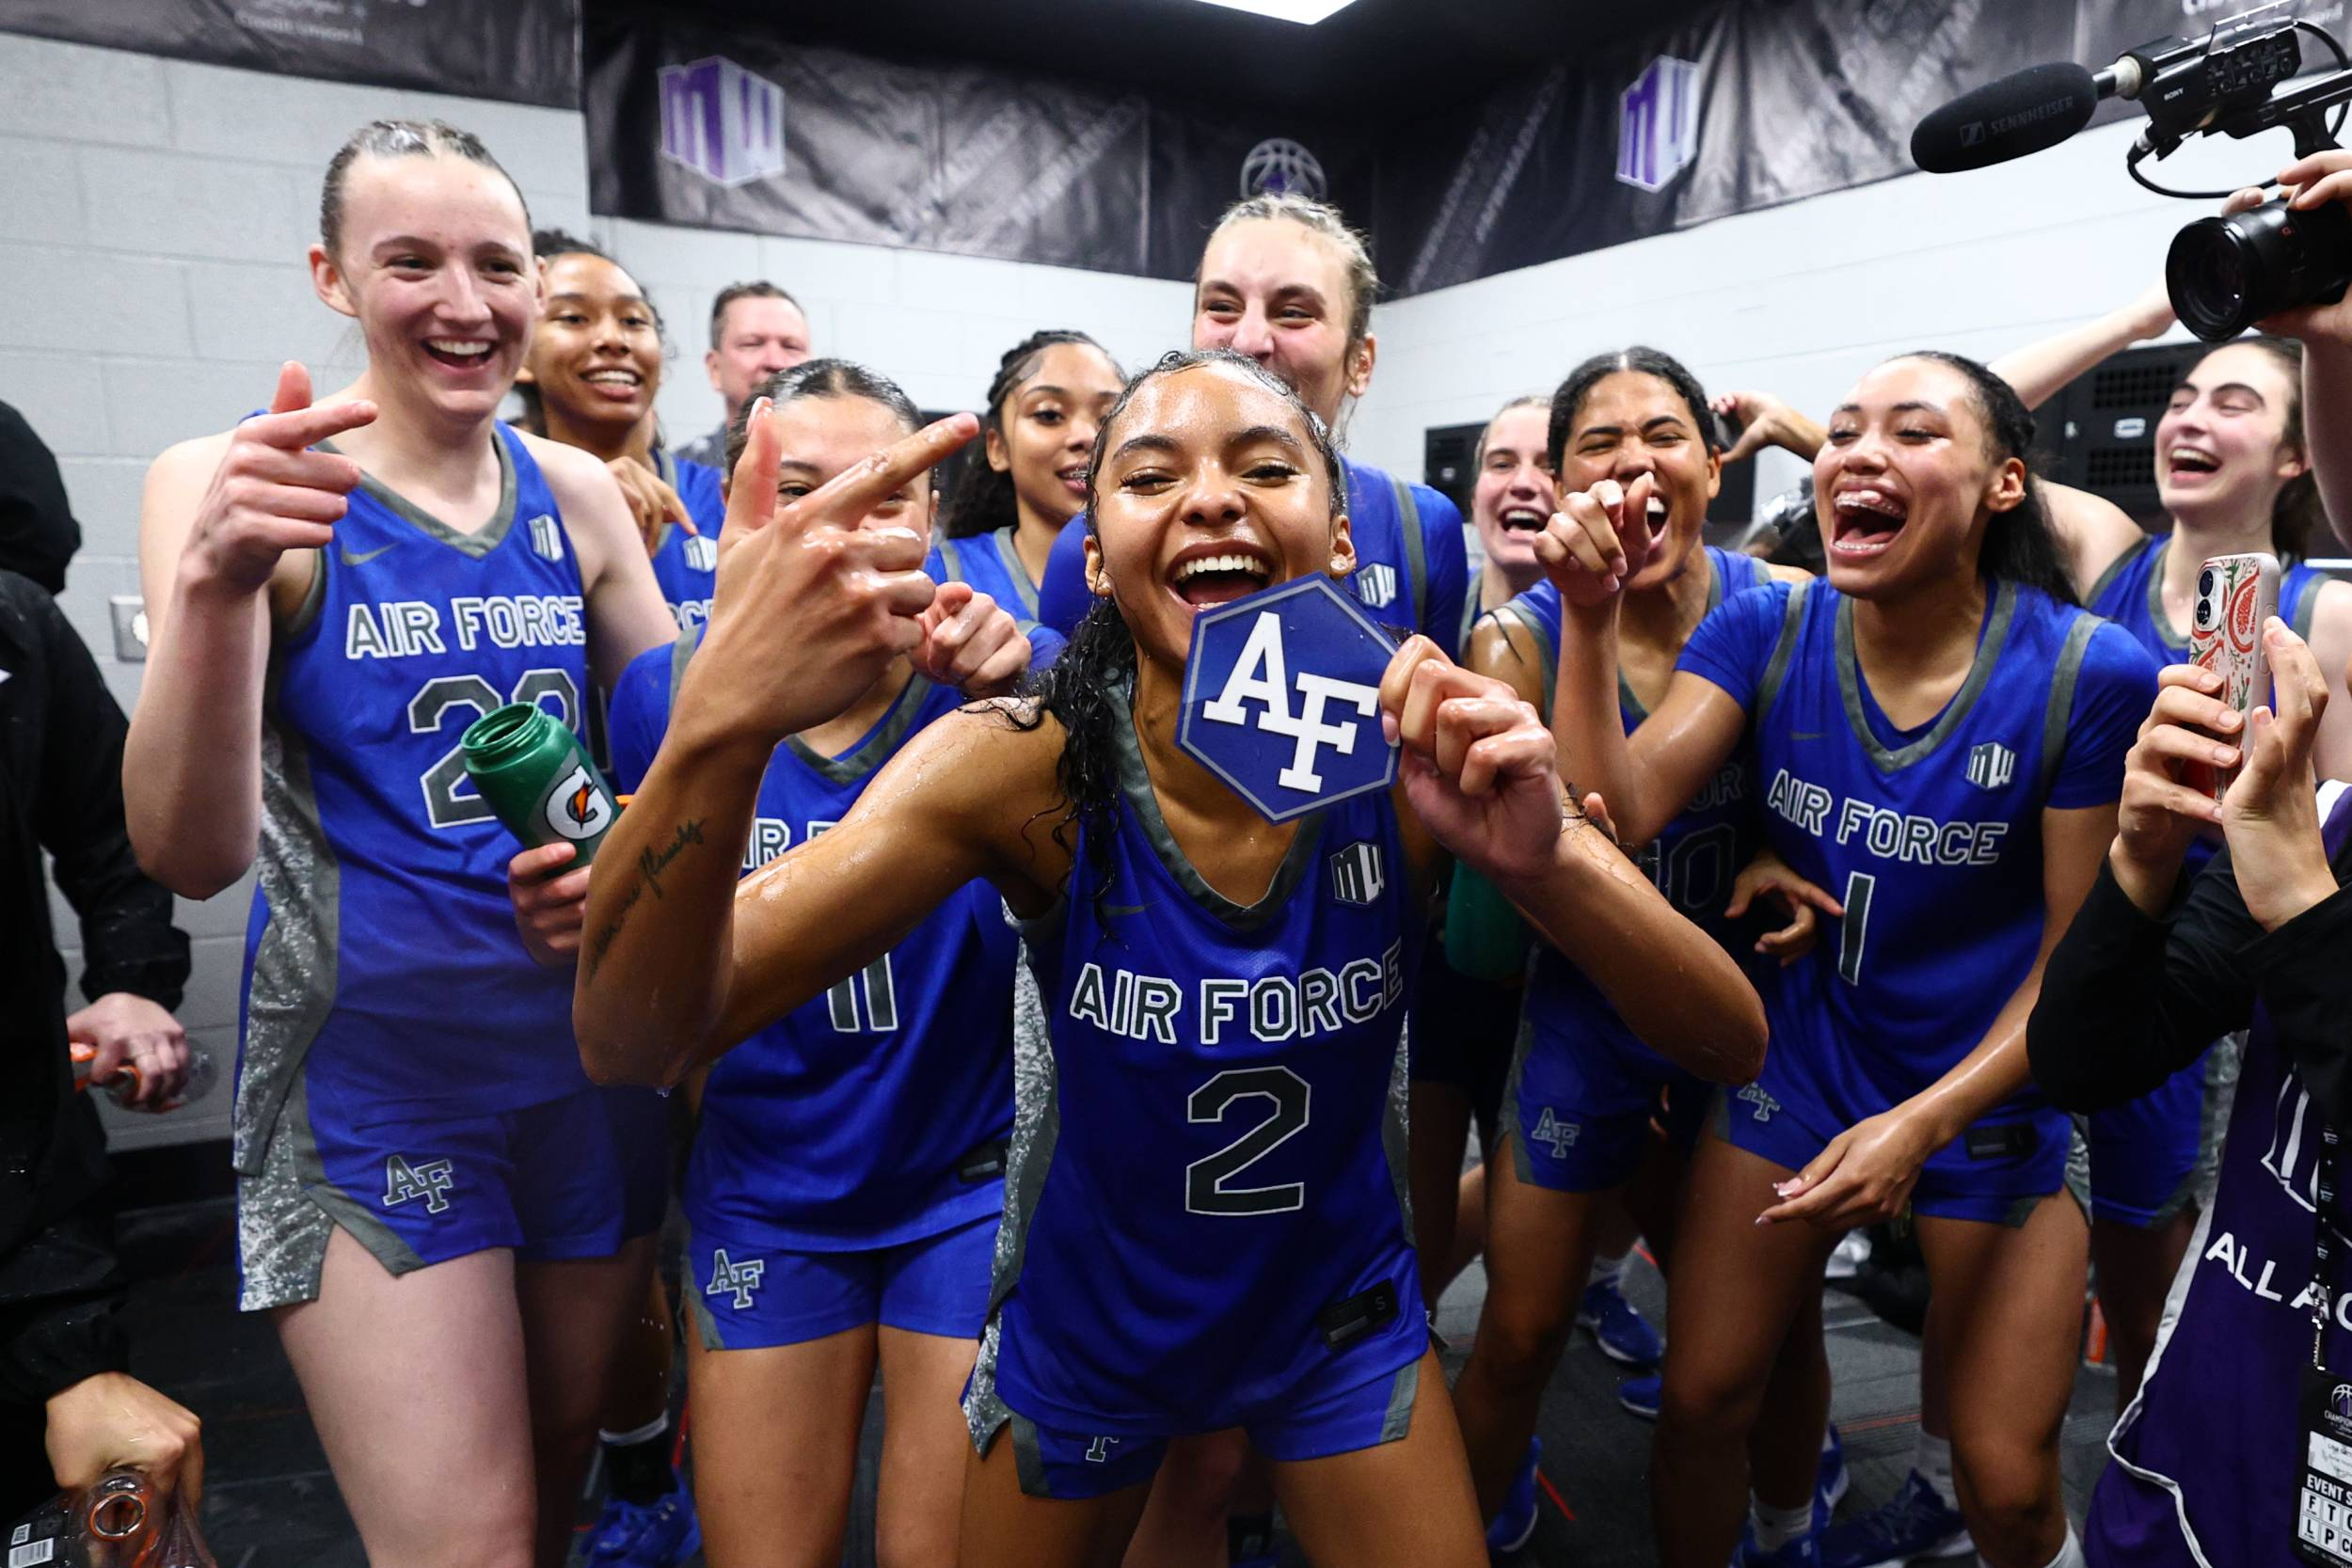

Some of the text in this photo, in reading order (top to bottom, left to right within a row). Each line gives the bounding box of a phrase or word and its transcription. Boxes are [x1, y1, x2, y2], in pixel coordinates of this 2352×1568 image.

[1990, 95, 2074, 135] SENNHEISER
[2164, 87, 2184, 101] SONY
[345, 595, 587, 659] AIR FORCE
[1202, 610, 1380, 794] AF
[544, 764, 612, 841] G
[1768, 768, 1833, 837] AIR
[1836, 797, 2010, 865] FORCE
[1838, 870, 1876, 987] 1
[1069, 935, 1403, 1046] AIR FORCE
[1185, 1065, 1311, 1216] 2
[1531, 1106, 1581, 1159] AF
[382, 1154, 453, 1213] AF
[707, 1248, 765, 1310] AF
[2204, 1231, 2283, 1303] ALL
[2306, 1473, 2344, 1501] EVENT
[2309, 1494, 2317, 1510] F
[2328, 1503, 2337, 1522] T
[2307, 1518, 2314, 1535] L
[2325, 1528, 2335, 1545] P
